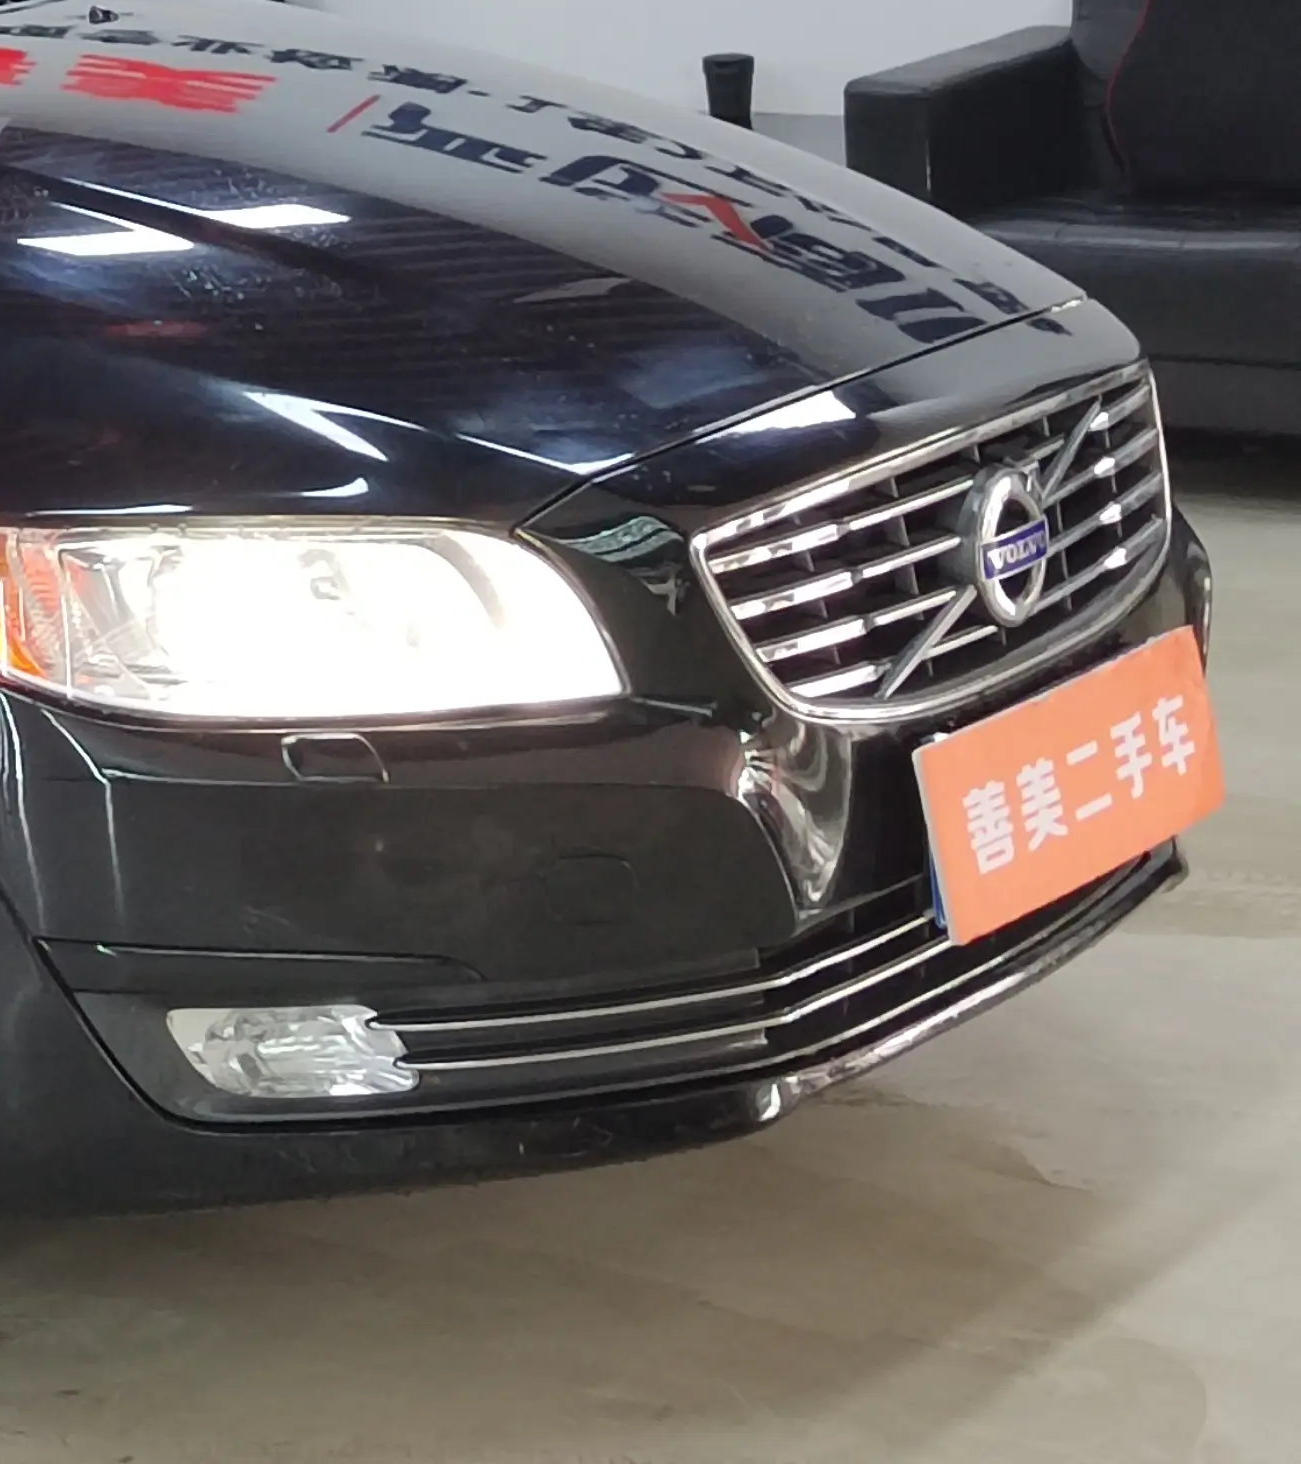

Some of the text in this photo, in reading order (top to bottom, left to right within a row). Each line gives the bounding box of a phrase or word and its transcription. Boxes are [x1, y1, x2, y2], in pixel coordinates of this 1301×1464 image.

[962, 694, 1195, 875] 善美二手车
